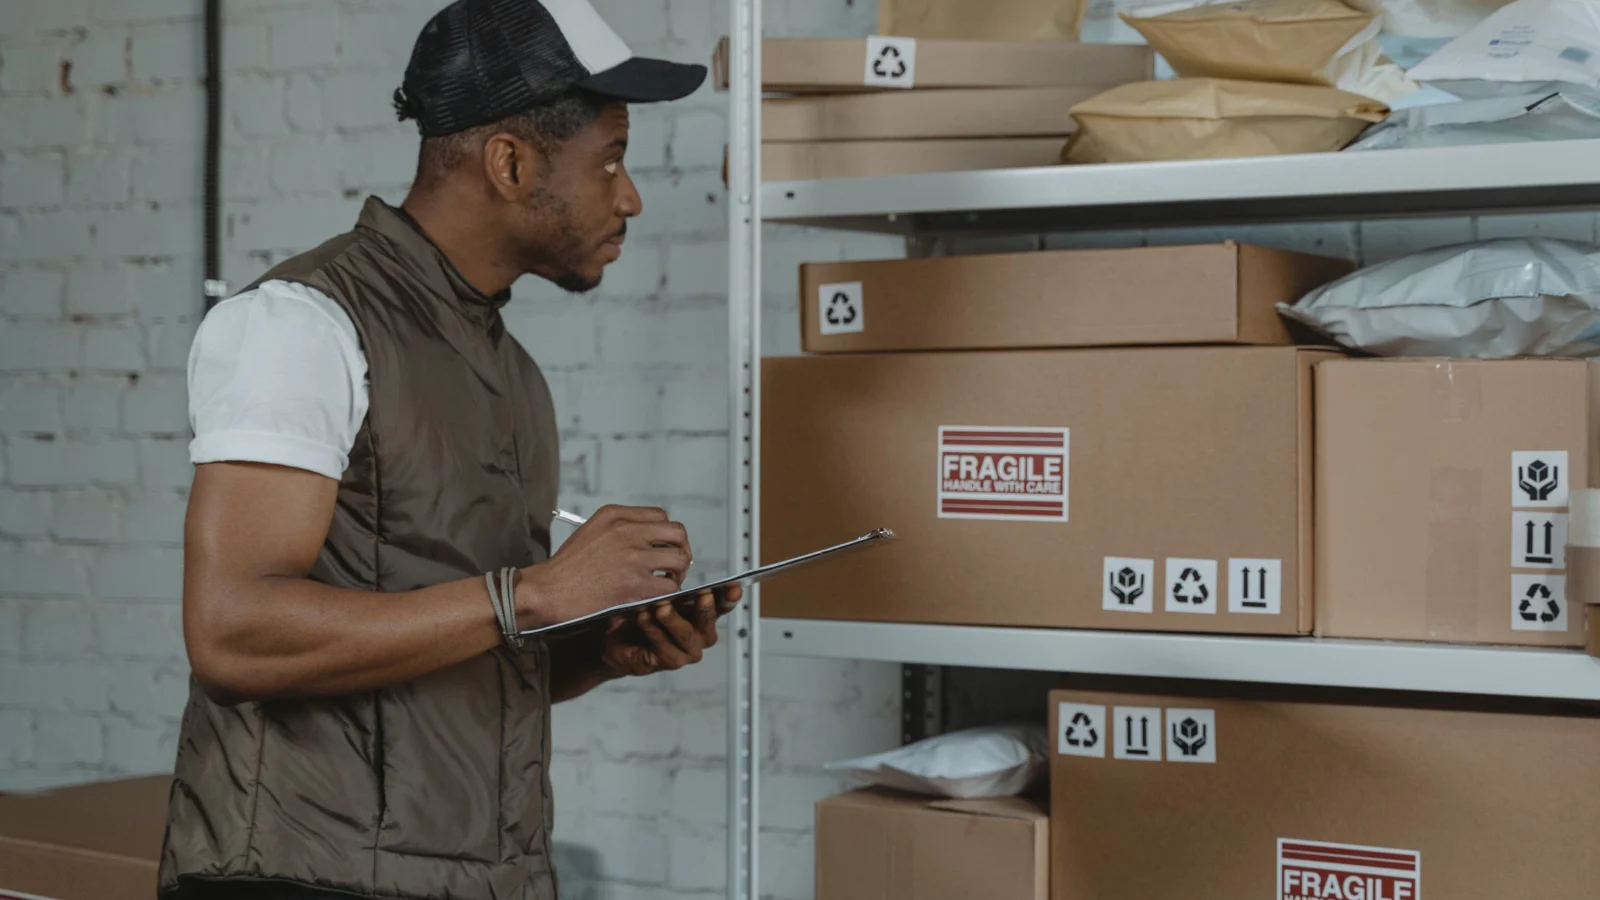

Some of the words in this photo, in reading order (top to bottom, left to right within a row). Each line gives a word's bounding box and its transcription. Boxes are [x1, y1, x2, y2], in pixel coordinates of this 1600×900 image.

[943, 455, 1061, 481] FRAGILE
[943, 479, 992, 492] HANDLE
[993, 480, 1024, 493] WITH
[1026, 481, 1061, 494] CARE
[1284, 869, 1412, 900] FRAGILE
